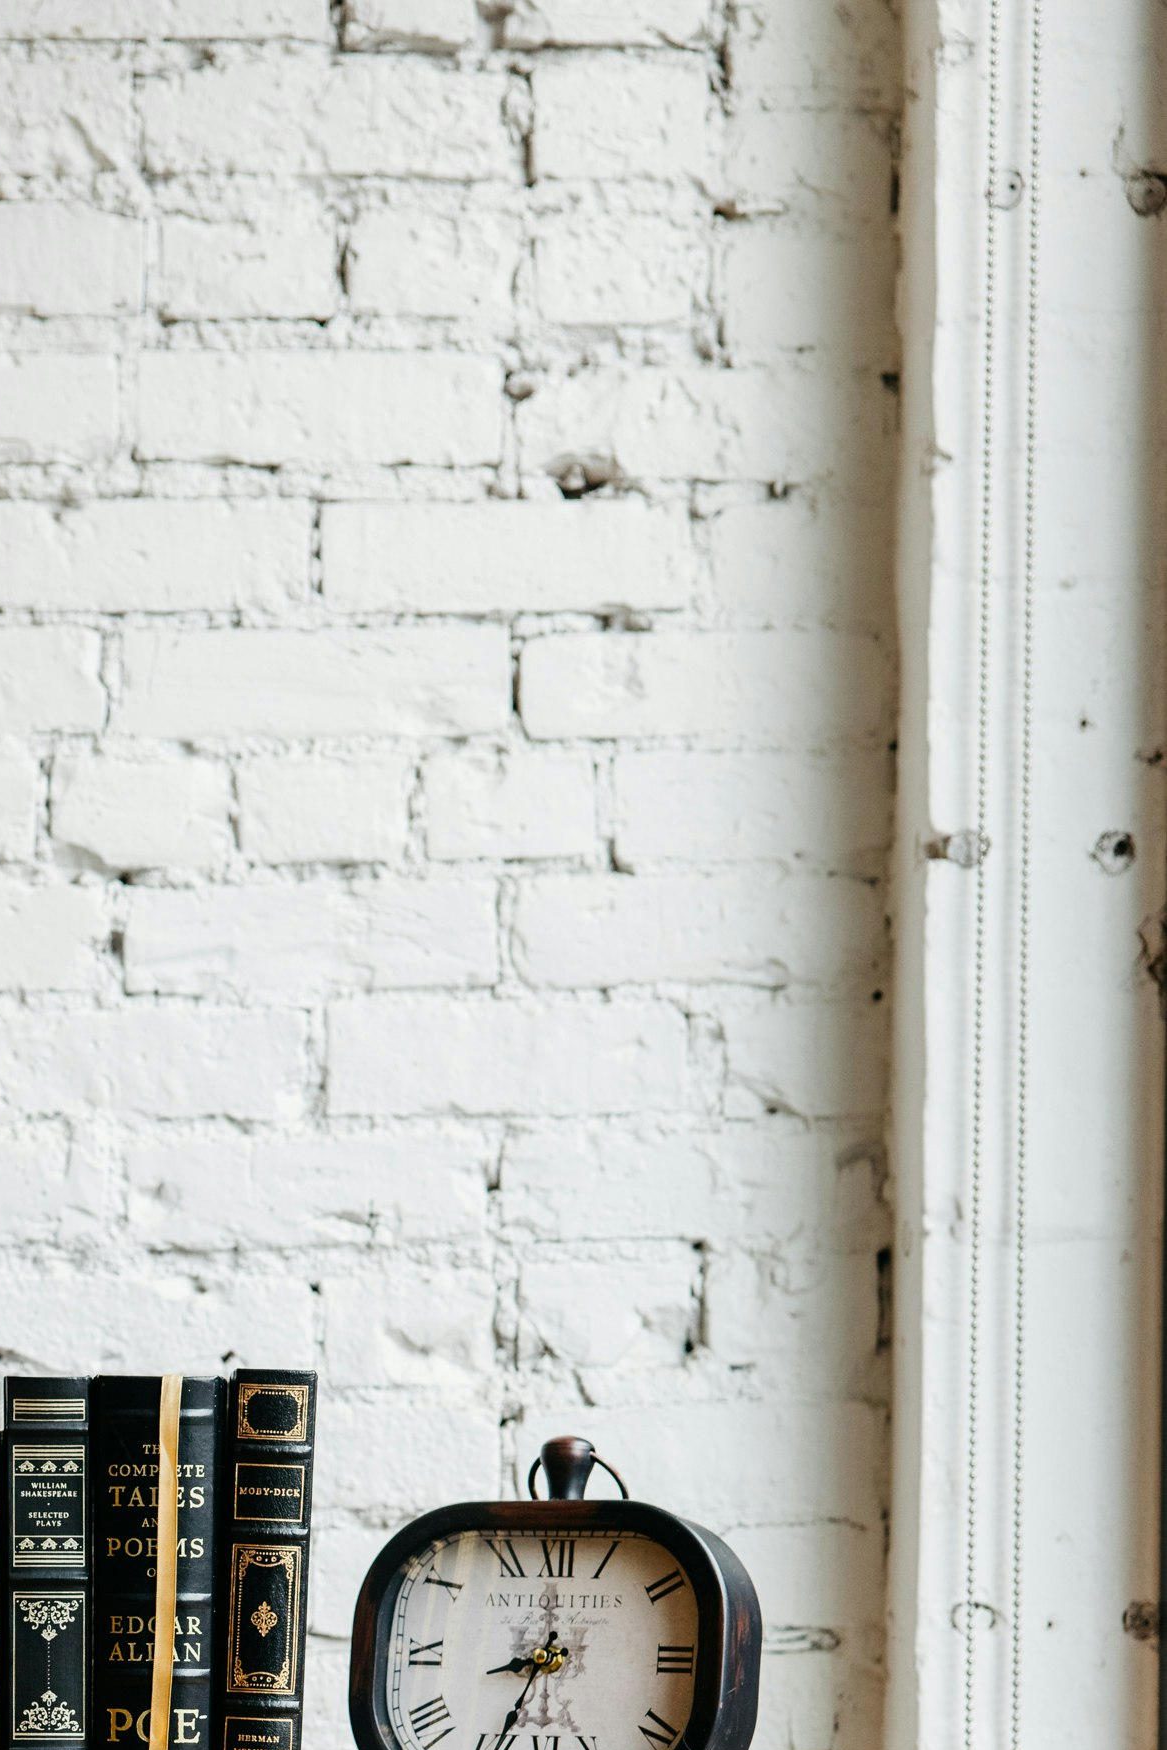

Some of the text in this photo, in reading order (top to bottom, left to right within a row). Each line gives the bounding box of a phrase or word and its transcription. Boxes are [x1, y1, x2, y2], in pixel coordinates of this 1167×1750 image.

[142, 1444, 161, 1455] TH
[107, 1464, 205, 1478] COMPETE
[31, 1482, 68, 1490] WILLIAM
[20, 1490, 78, 1498] SHAKESPEARE
[239, 1486, 301, 1499] MOBY-DICK
[28, 1511, 70, 1519] SELECTED
[141, 1517, 159, 1528] AN
[537, 1539, 575, 1579] XII
[146, 1567, 157, 1578] O
[485, 1592, 624, 1610] ANTIQUITIES
[237, 1733, 281, 1744] HERMAN
